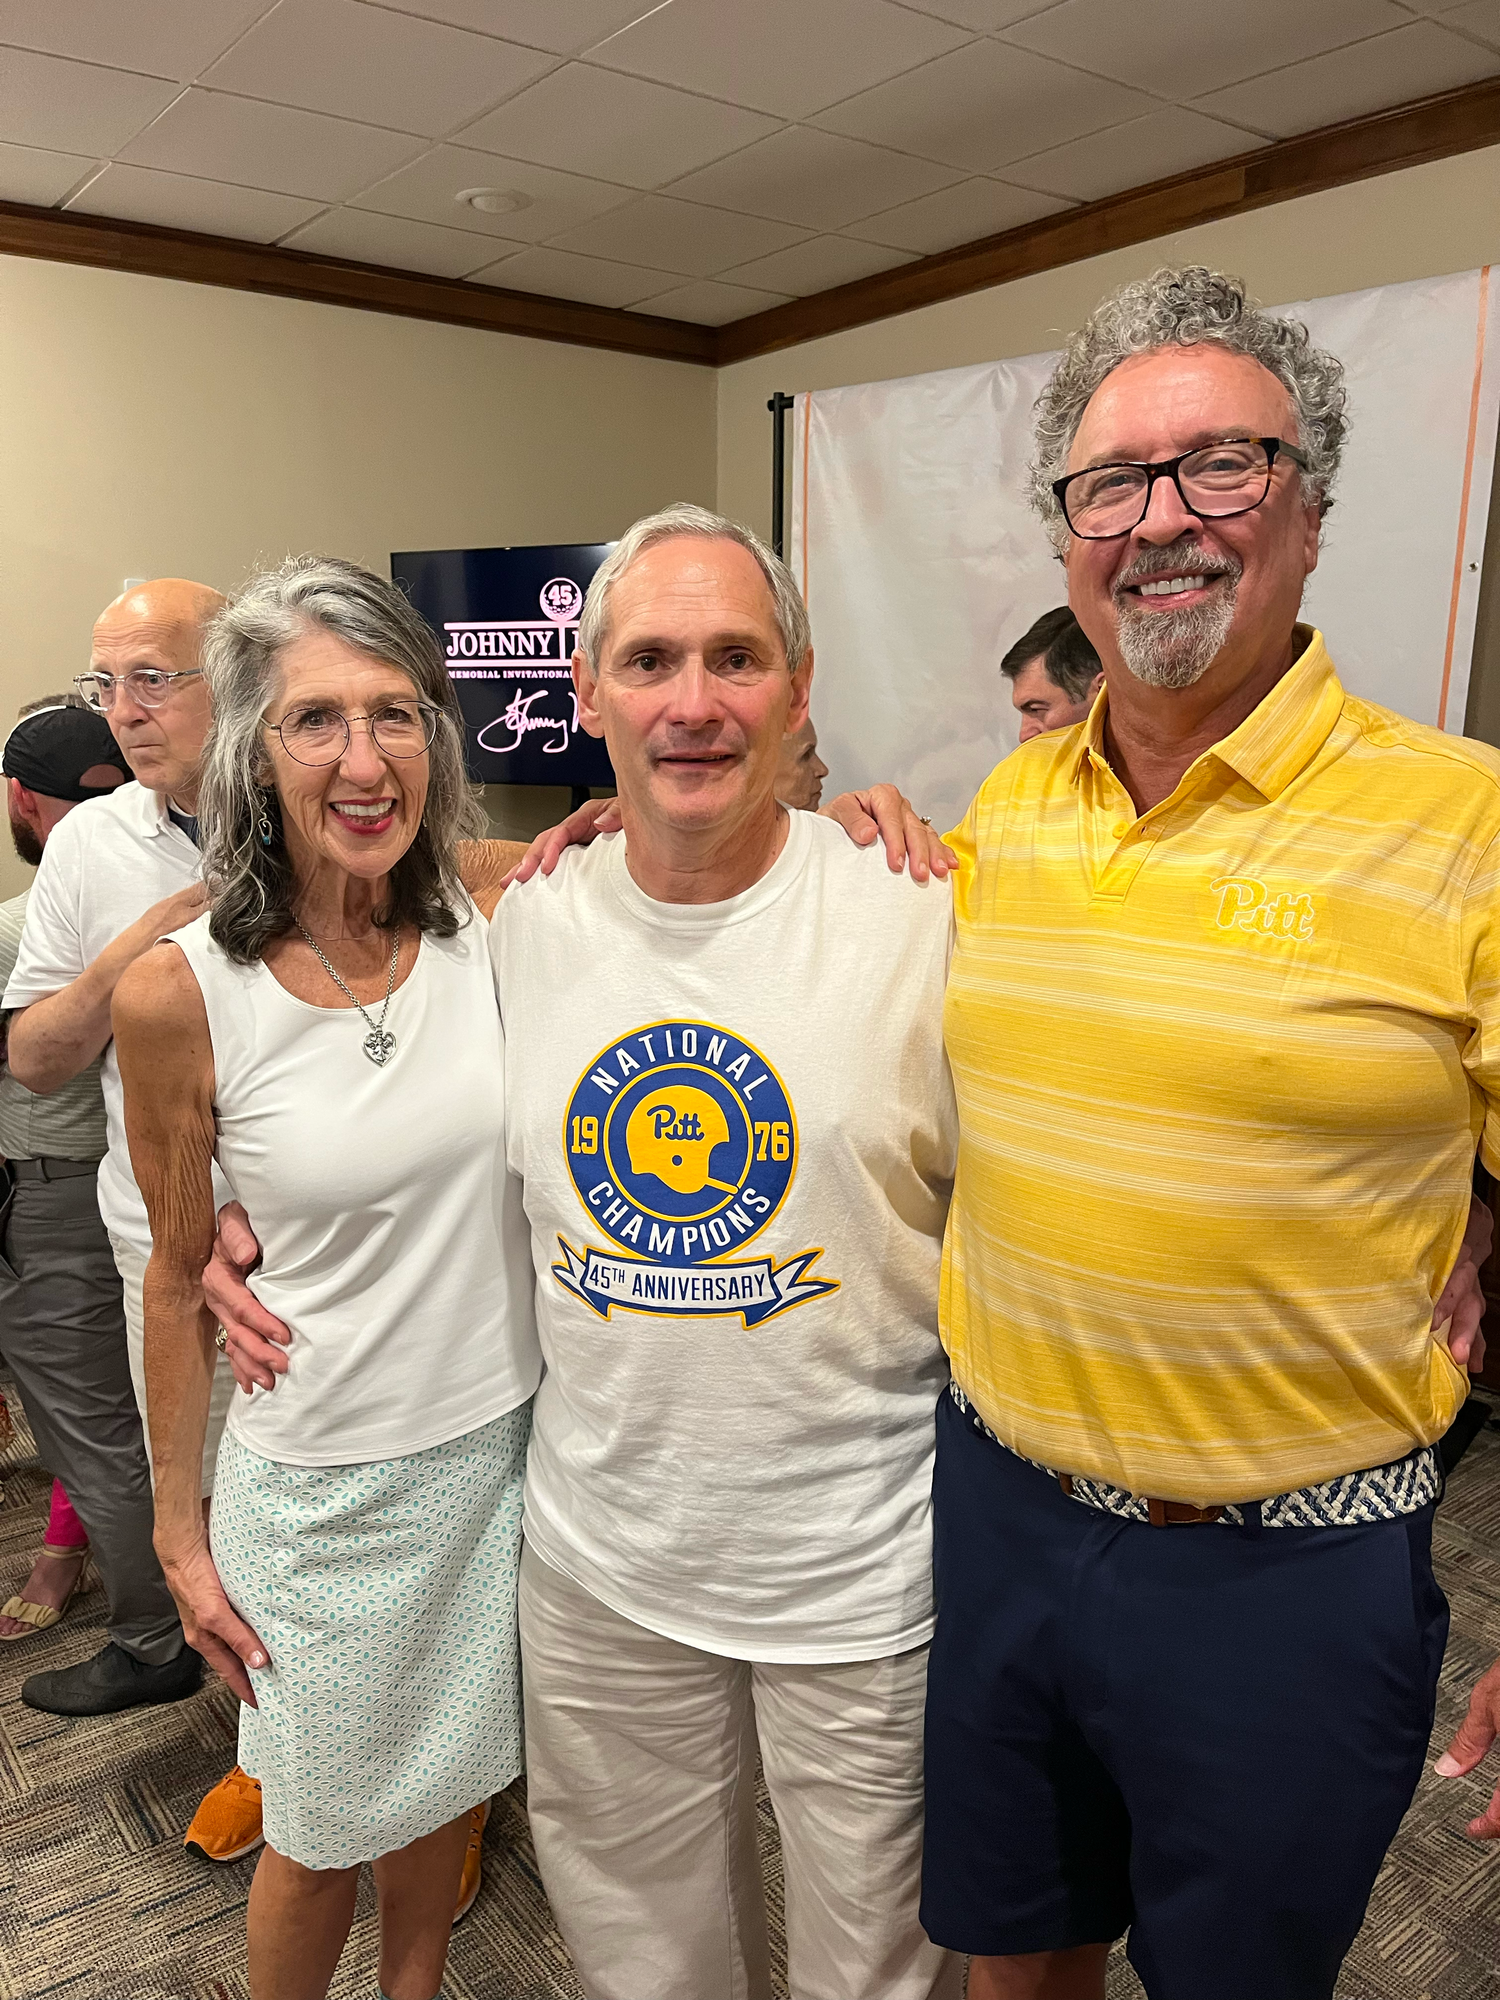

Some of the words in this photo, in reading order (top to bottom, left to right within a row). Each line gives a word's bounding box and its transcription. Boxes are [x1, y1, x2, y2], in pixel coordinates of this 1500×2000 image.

[549, 585, 572, 606] 45
[447, 631, 554, 656] JOHNNY
[1210, 876, 1314, 941] Pitt
[590, 1029, 769, 1101] NATIONAL
[571, 1115, 599, 1155] 19
[646, 1104, 705, 1141] Pitt
[754, 1121, 790, 1162] 76
[588, 1181, 771, 1256] CHAMPIONS
[589, 1264, 625, 1290] 45TH
[632, 1273, 766, 1302] ANNIVERSARY
